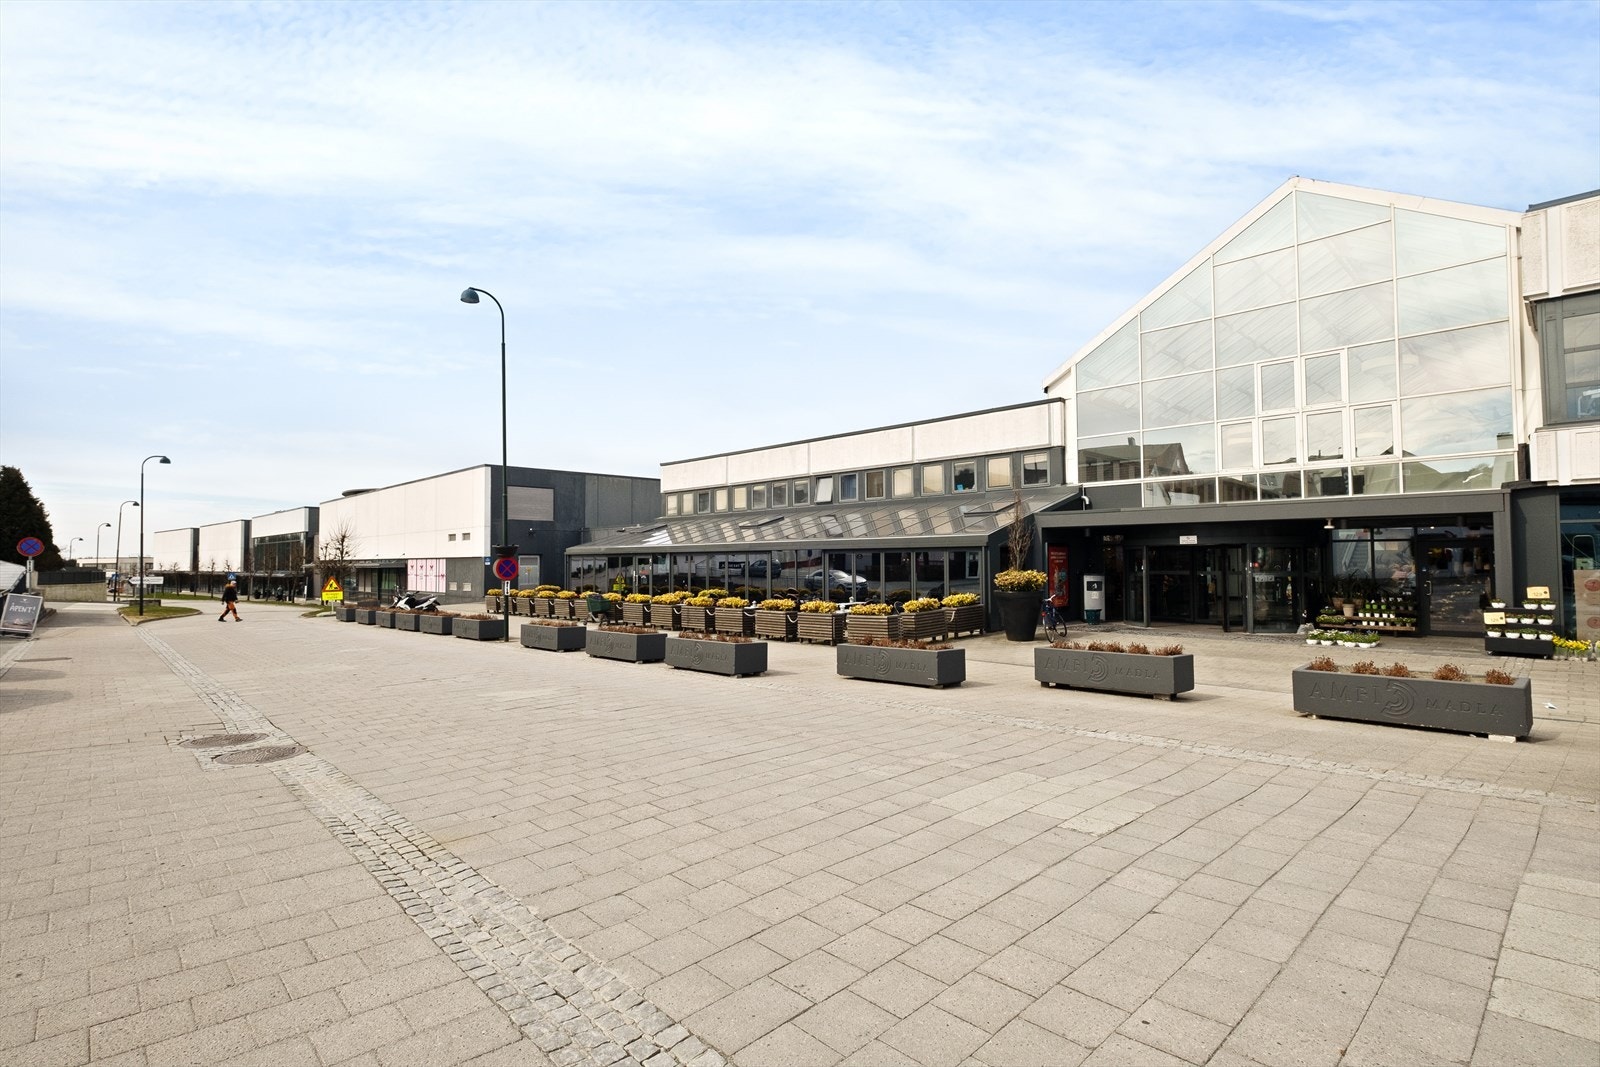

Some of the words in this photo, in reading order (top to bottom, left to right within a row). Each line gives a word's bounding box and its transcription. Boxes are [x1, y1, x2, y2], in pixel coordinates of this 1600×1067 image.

[1044, 655, 1087, 674] AMFI
[1115, 666, 1161, 680] MADLA
[1309, 679, 1382, 705] AMFI
[1425, 697, 1504, 718] MADLA
